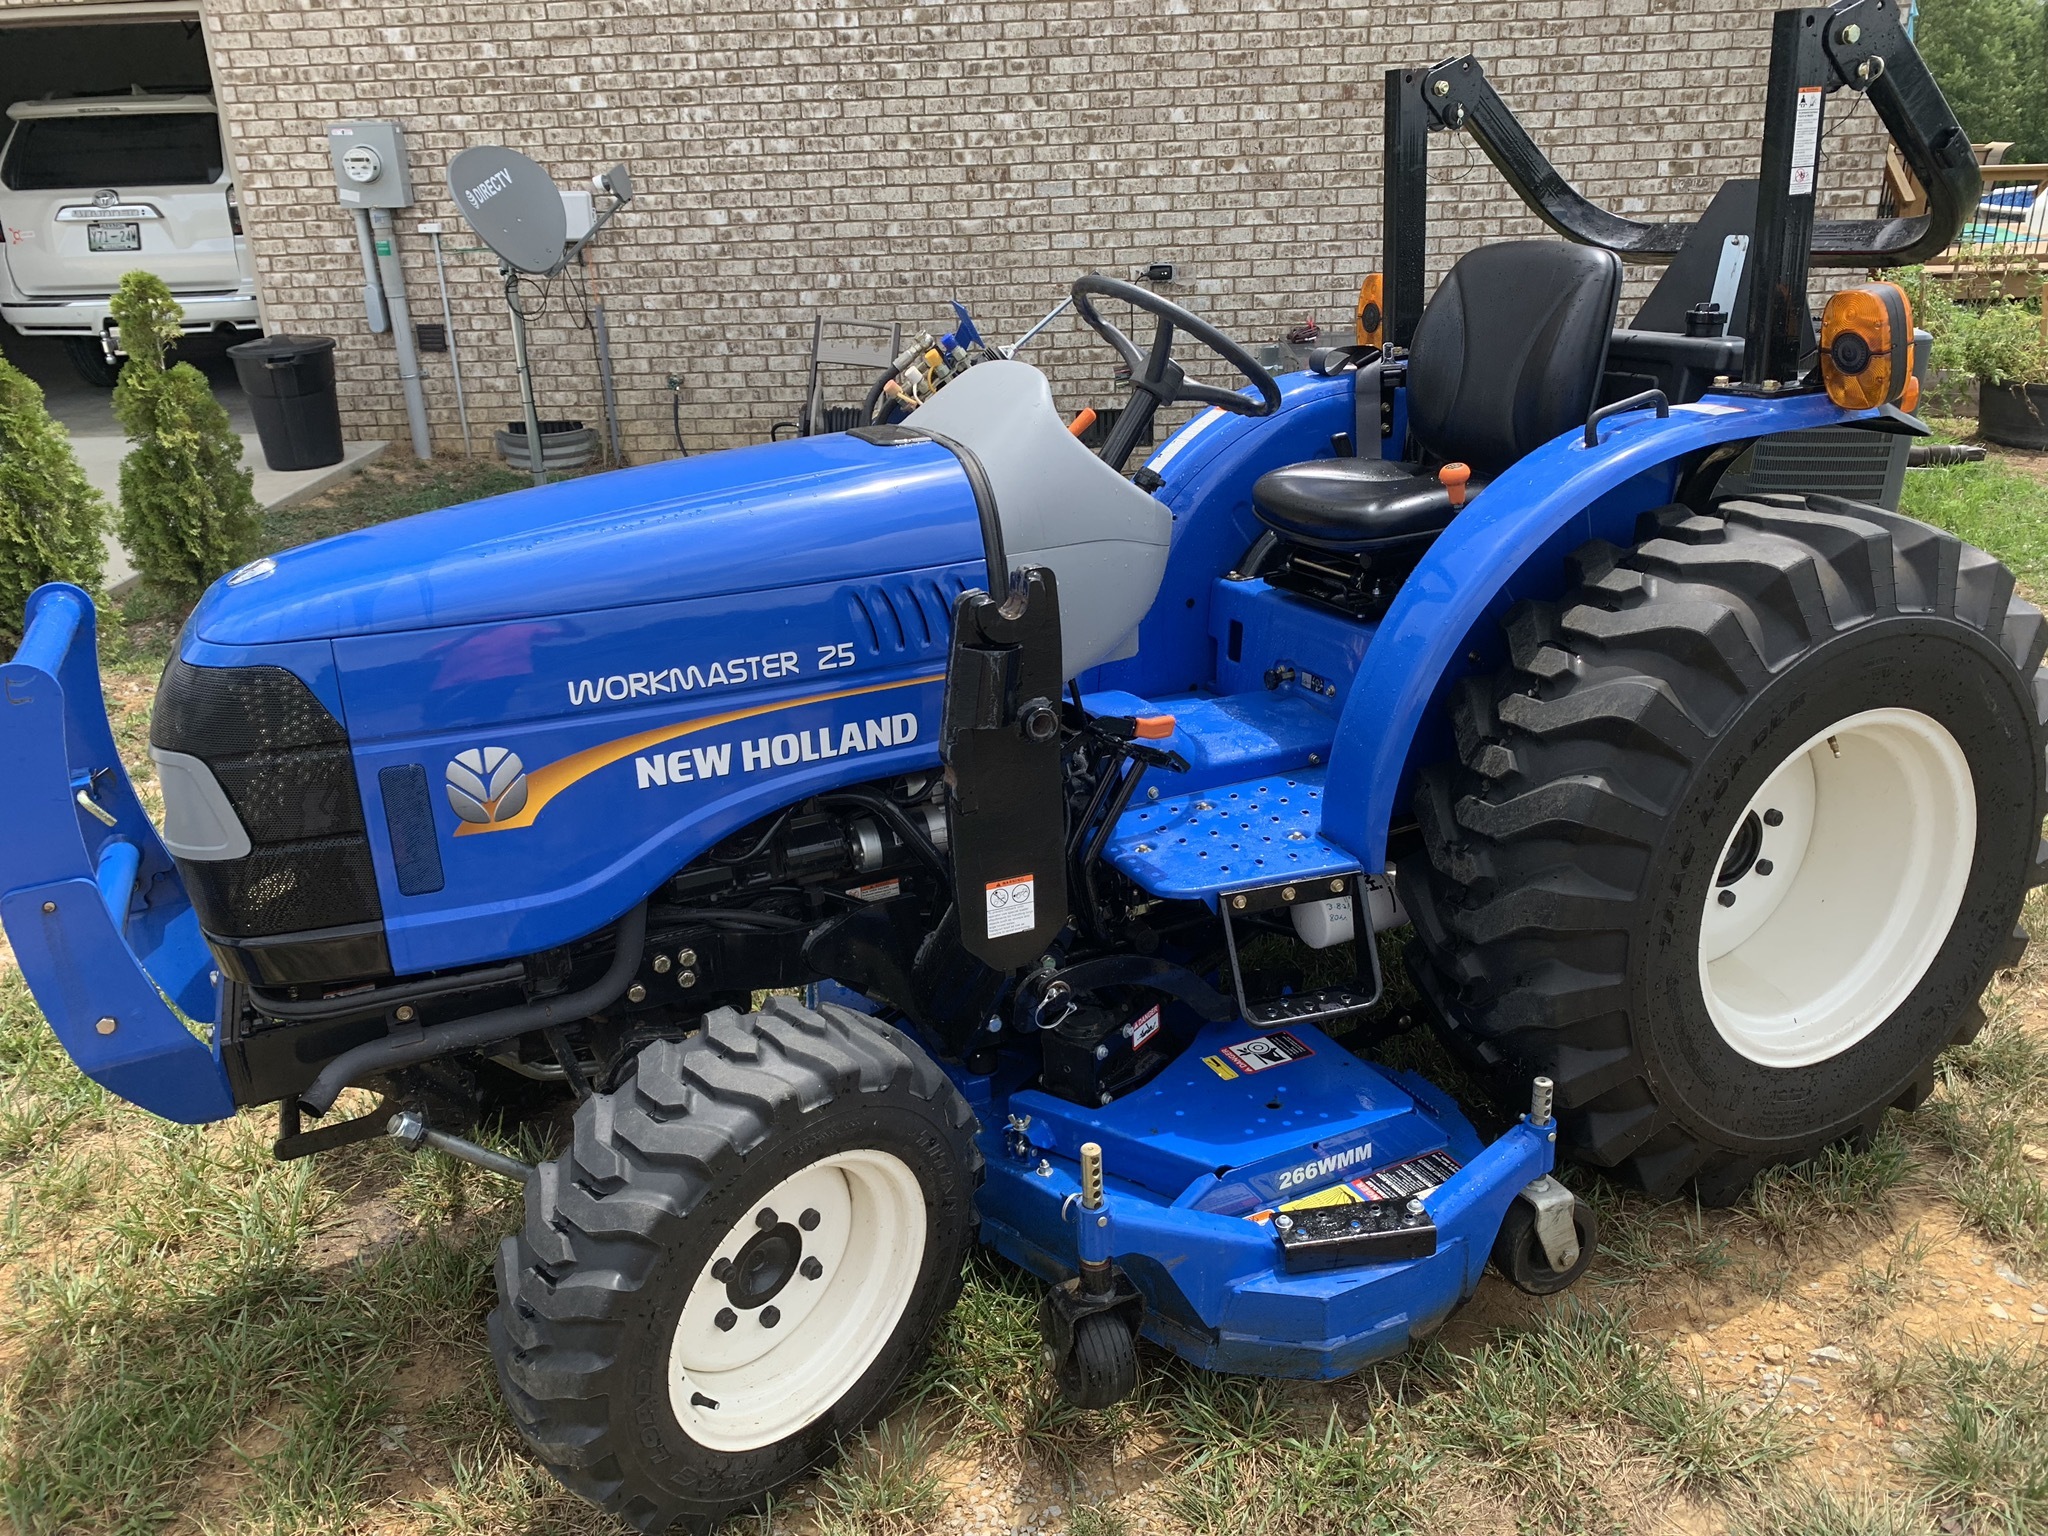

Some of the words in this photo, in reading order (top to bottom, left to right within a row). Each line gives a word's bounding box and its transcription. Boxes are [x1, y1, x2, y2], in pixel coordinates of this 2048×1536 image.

[472, 167, 513, 204] DIRECTV
[567, 651, 800, 706] WORKMASTER
[818, 642, 856, 672] 25
[635, 742, 732, 790] NEW
[742, 712, 919, 772] HOLLAND
[1220, 1048, 1247, 1070] DANGER
[1278, 1142, 1373, 1191] 266WMM
